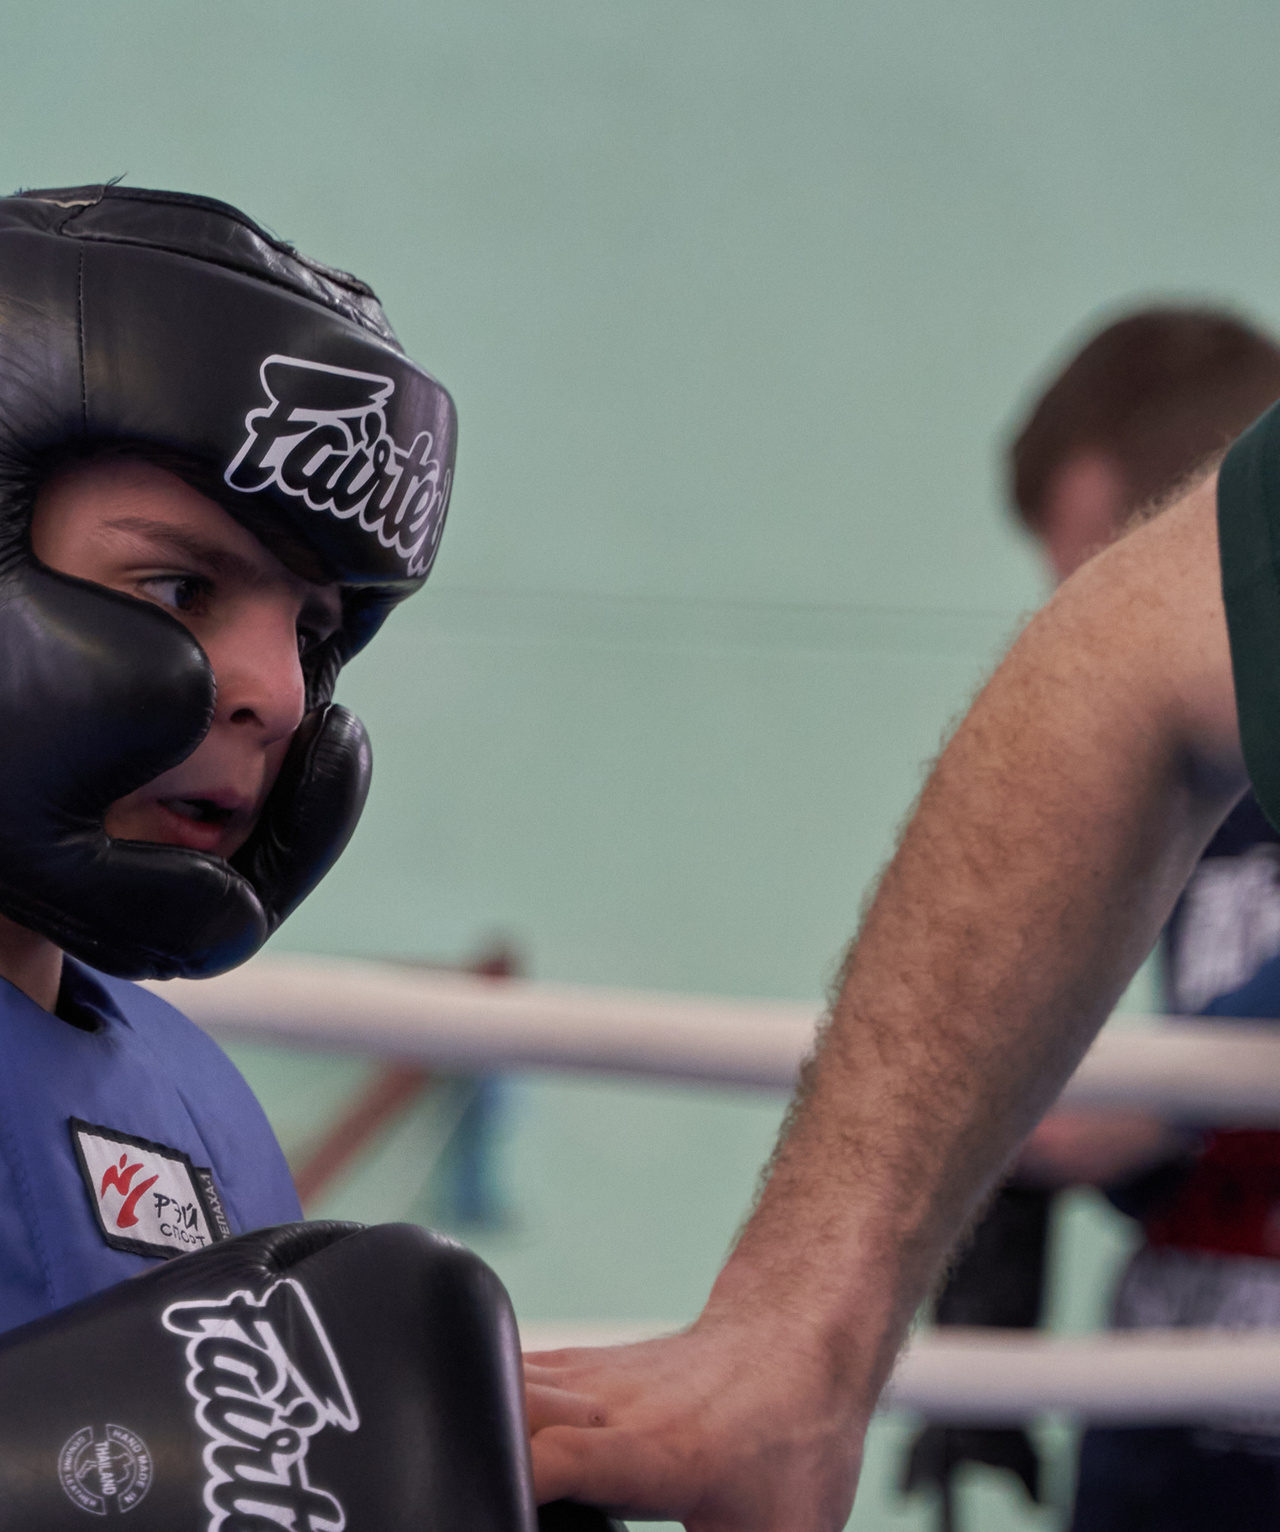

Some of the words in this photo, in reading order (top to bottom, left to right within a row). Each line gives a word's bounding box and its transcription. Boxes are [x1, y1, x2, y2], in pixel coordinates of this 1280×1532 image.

[224, 354, 451, 577] Fairtex
[62, 1435, 87, 1472] GENUINE
[112, 1430, 142, 1453] HAND
[95, 1440, 118, 1496] THAILAND
[136, 1455, 148, 1488] MADE
[62, 1474, 98, 1508] LEATHER
[123, 1491, 137, 1504] IN
